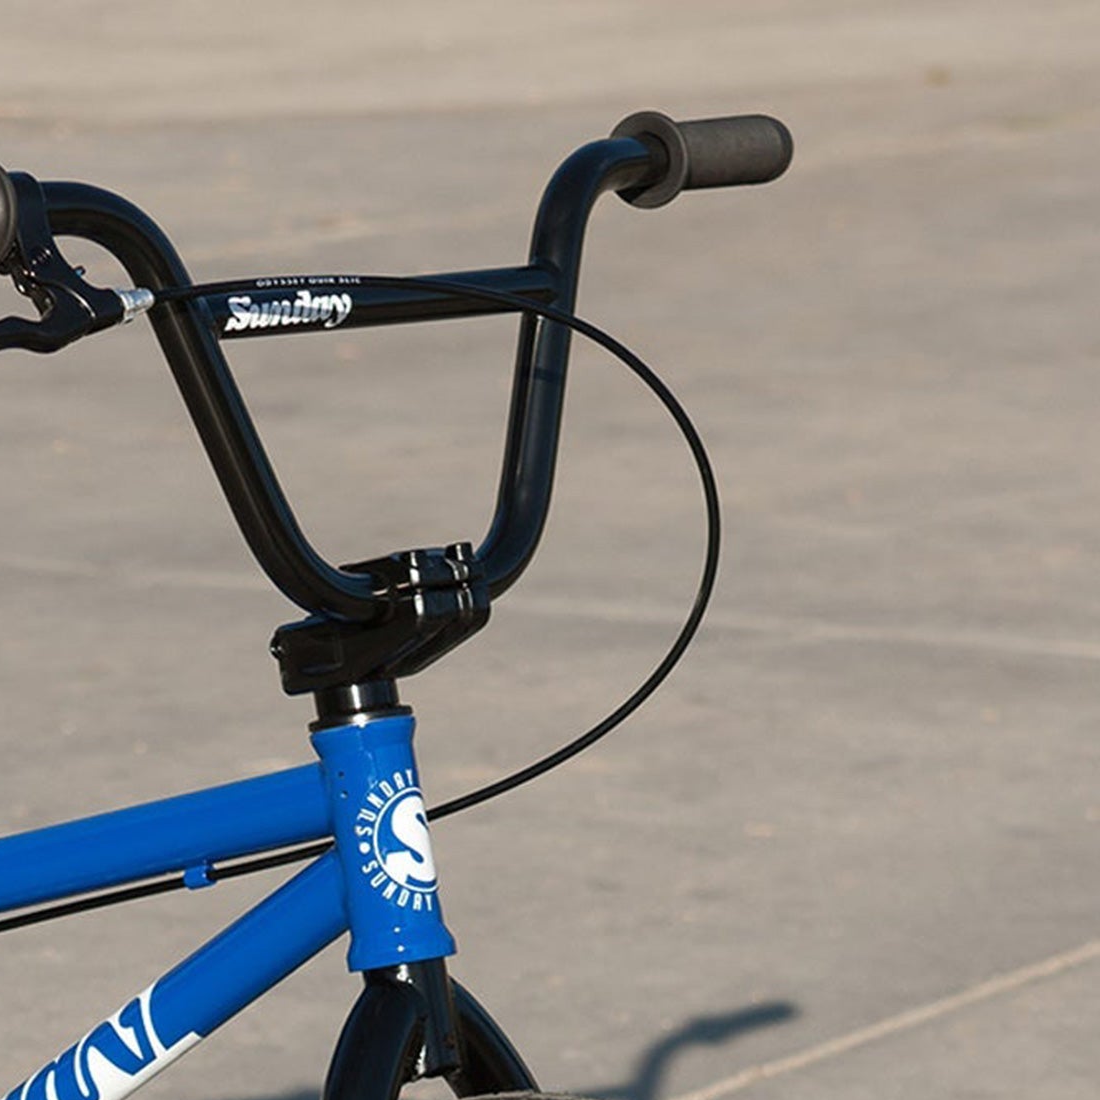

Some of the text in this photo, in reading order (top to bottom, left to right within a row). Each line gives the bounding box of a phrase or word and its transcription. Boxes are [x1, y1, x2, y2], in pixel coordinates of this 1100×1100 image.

[224, 290, 352, 331] Sunday
[355, 768, 413, 837] SUNDAY
[361, 859, 432, 912] SUNDAY
